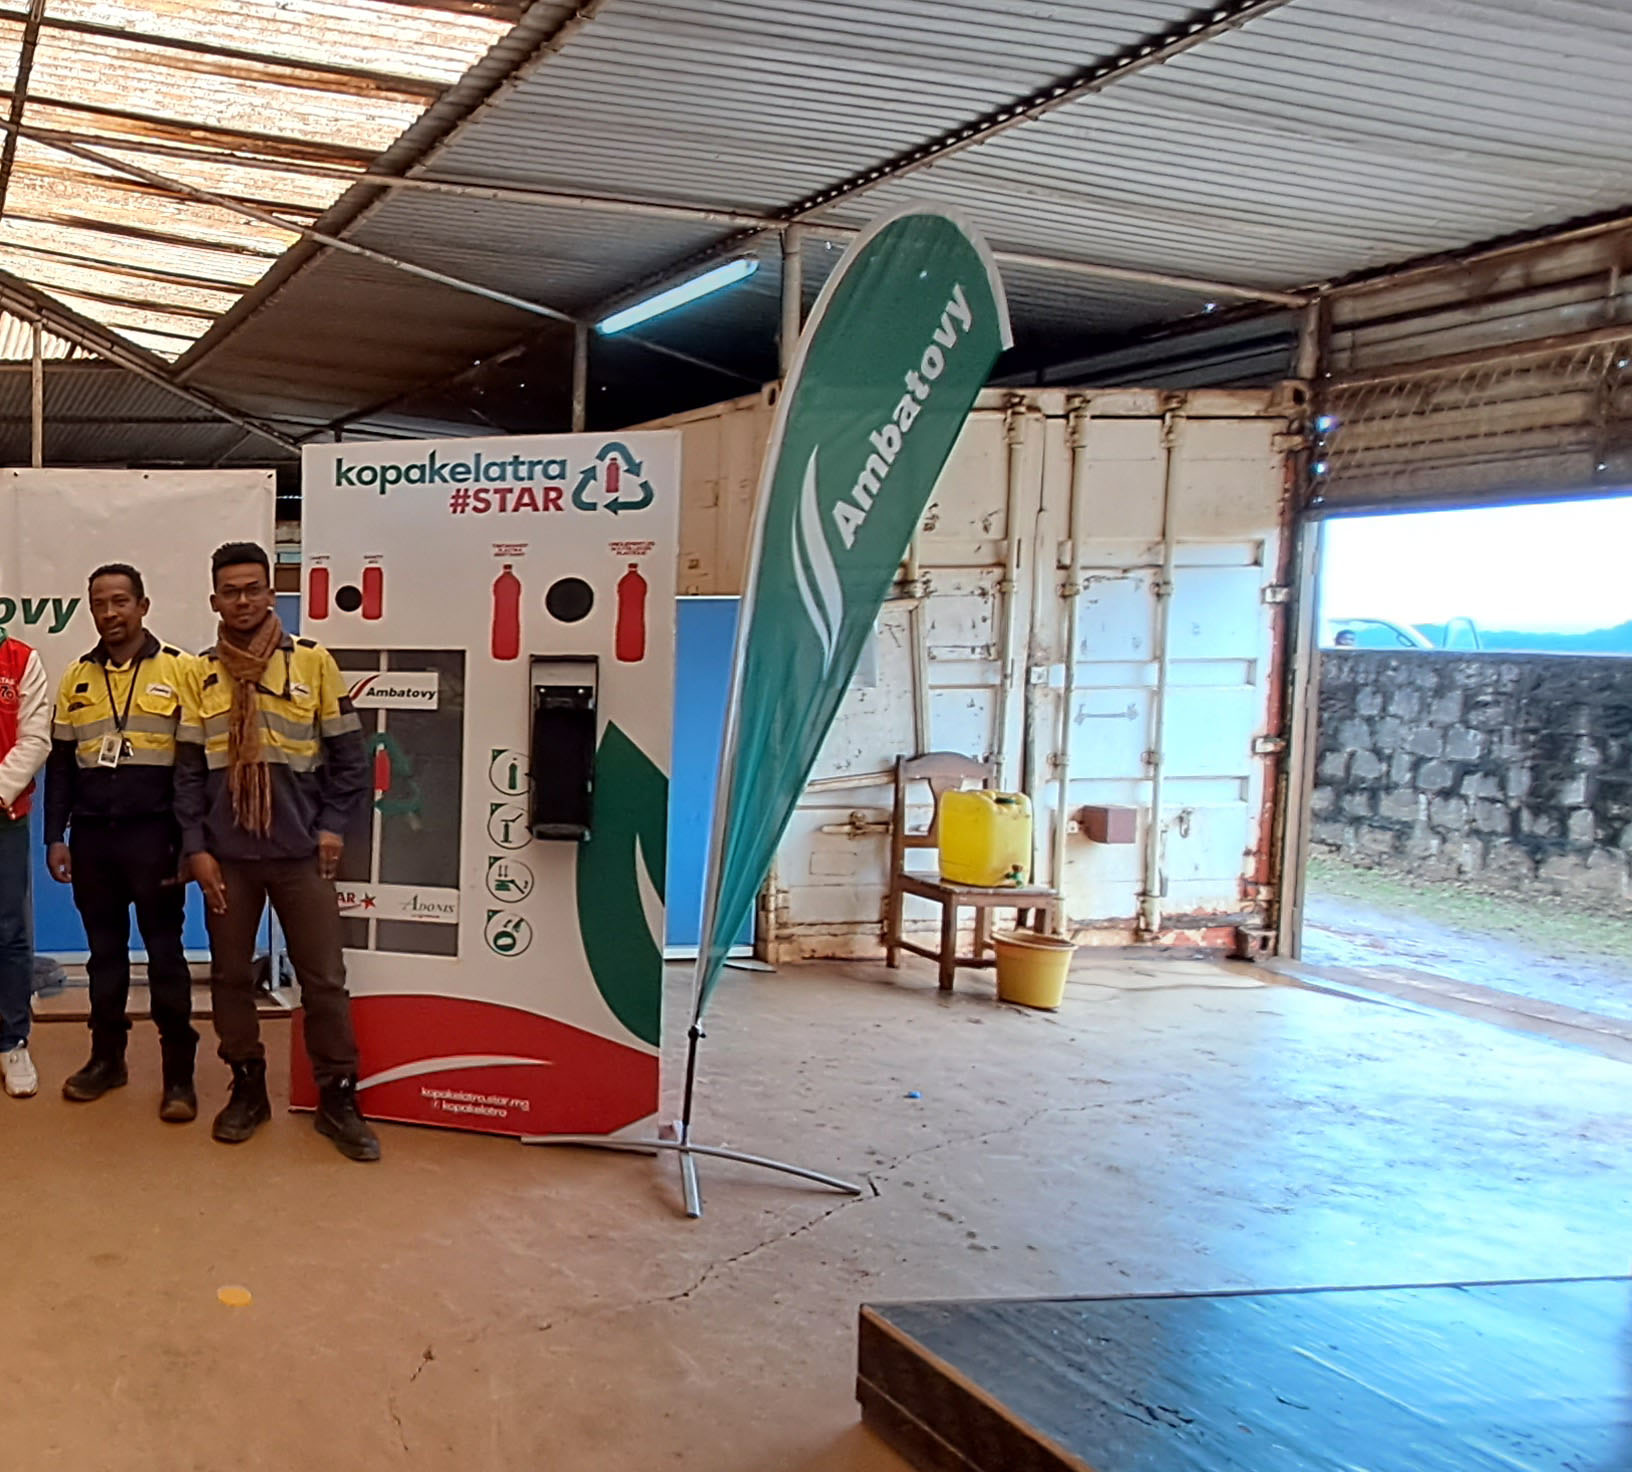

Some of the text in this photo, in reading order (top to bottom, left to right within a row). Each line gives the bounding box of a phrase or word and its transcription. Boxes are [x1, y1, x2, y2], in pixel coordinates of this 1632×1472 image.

[832, 282, 973, 550] Ambatovy
[335, 450, 567, 495] kopakelatra
[449, 486, 564, 514] #STAR
[366, 687, 436, 700] Ambatovy
[442, 1100, 508, 1118] kopakelatra
